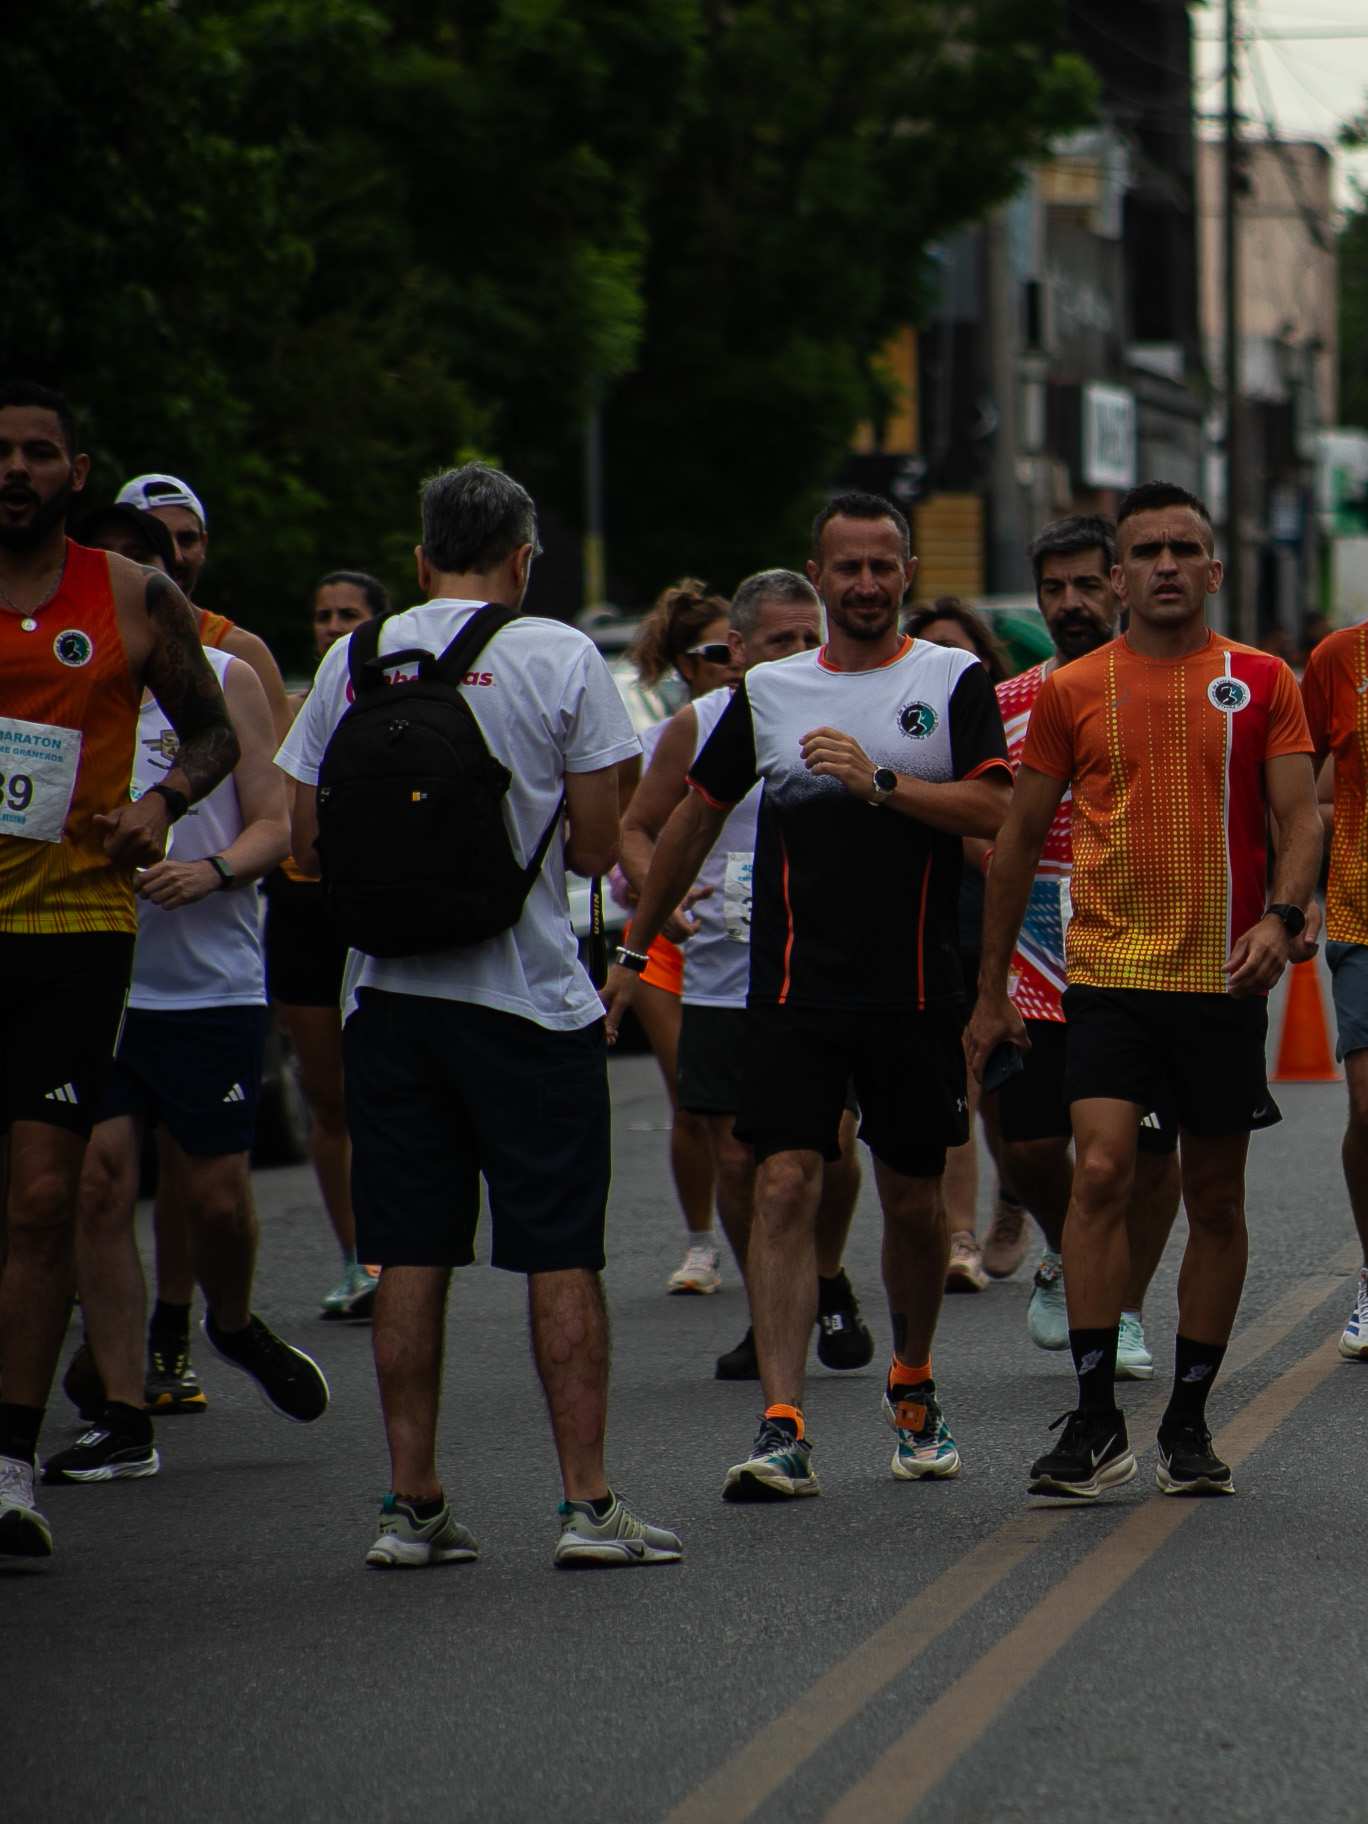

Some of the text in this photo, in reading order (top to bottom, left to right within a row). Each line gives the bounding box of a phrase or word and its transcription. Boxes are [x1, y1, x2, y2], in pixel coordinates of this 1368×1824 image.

[0, 731, 62, 750] ARATON
[13, 748, 63, 762] GRANEROS
[0, 773, 33, 811] 9
